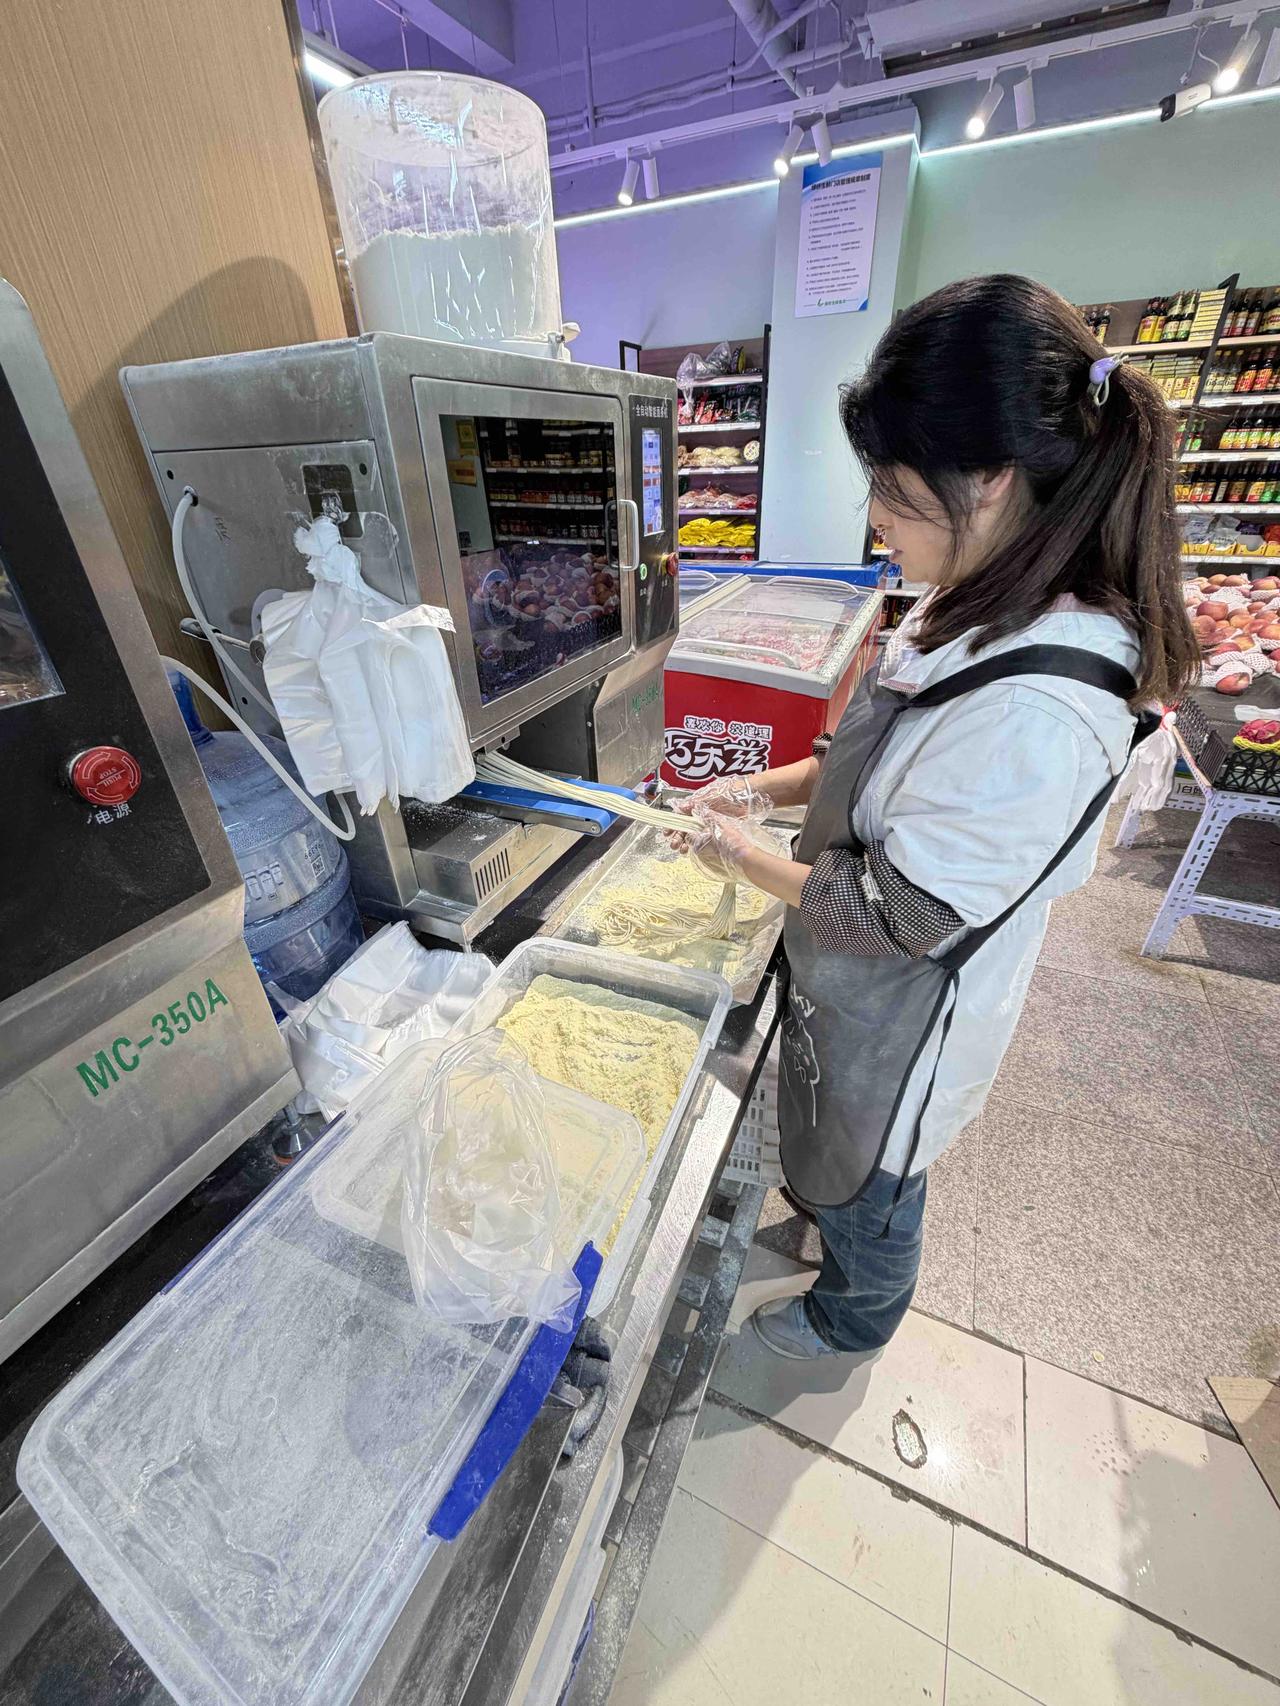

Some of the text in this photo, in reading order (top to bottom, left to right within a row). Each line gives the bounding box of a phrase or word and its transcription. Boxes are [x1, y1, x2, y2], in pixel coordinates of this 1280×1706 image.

[685, 716, 772, 740] 喜欢你 没道理
[99, 766, 118, 780] STOP
[103, 774, 122, 787] PUSH
[95, 801, 132, 824] 电源
[76, 978, 229, 1097] MC-350A
